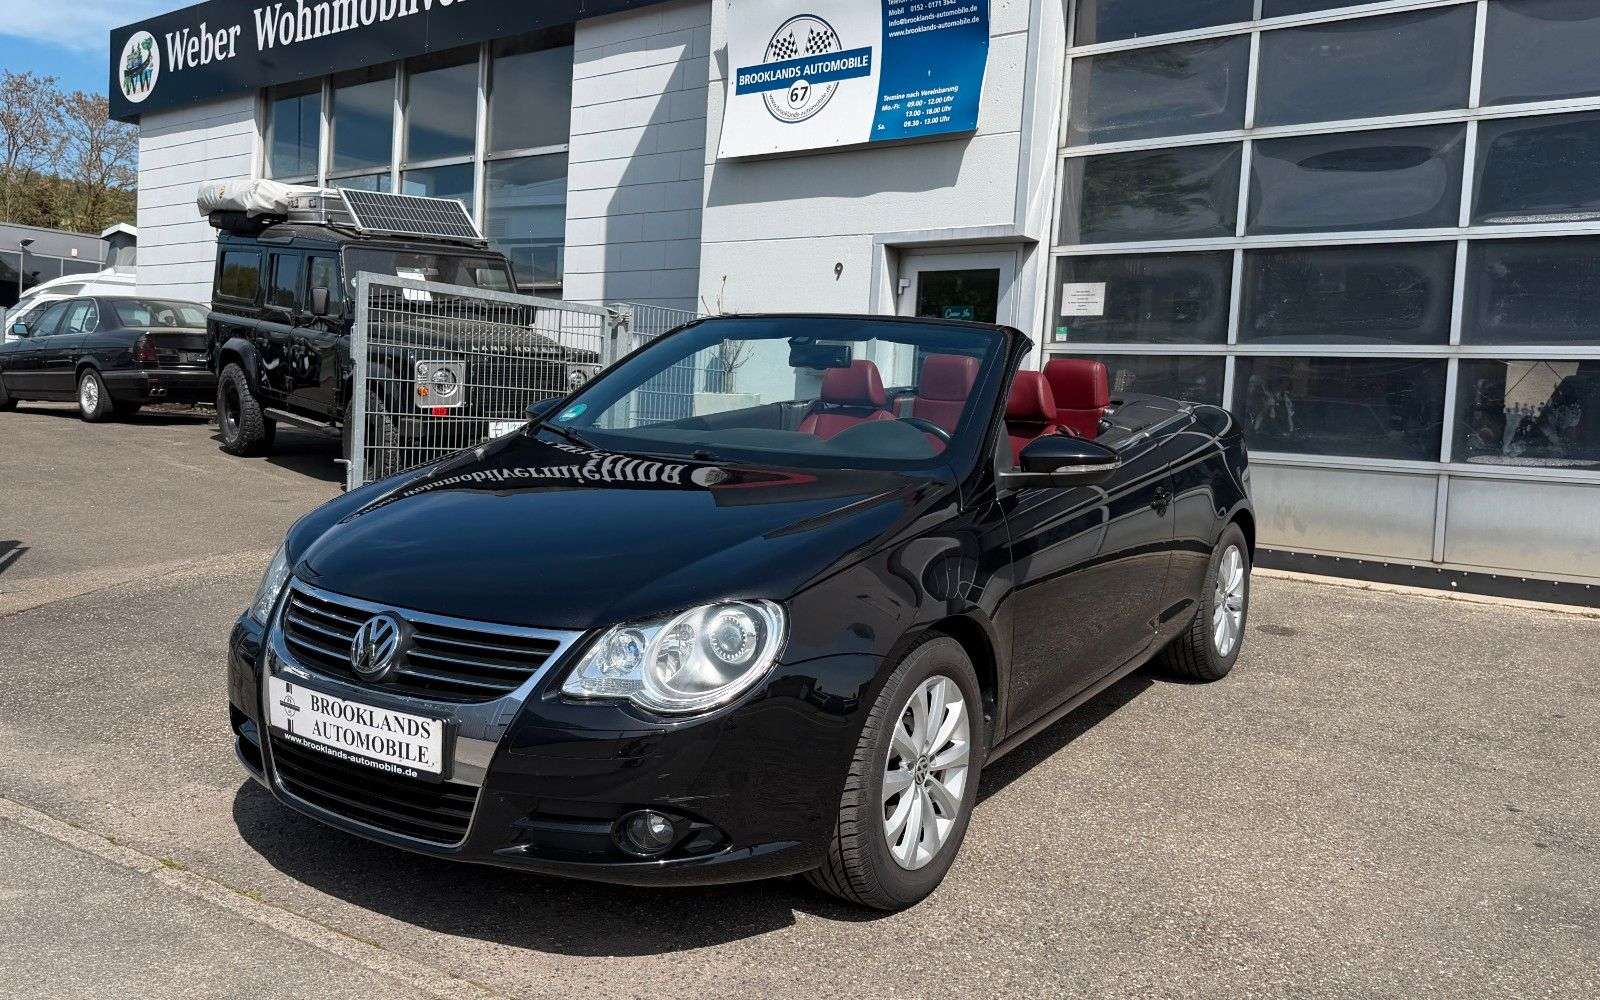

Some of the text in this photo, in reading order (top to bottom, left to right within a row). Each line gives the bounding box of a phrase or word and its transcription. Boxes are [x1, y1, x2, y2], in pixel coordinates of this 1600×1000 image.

[889, 8, 905, 16] Mobil
[889, 5, 978, 27] info@brooklands-automobile.de
[889, 16, 980, 37] www.brooklands-automobile.de
[166, 24, 240, 72] Weber
[739, 55, 869, 86] BROOKLANDS AUTOMOBILE
[790, 86, 808, 102] 67
[906, 91, 920, 99] nach
[833, 262, 844, 281] 9
[310, 694, 431, 740] BROOKLANDS
[284, 732, 418, 778] www.brooklands-automobile.de
